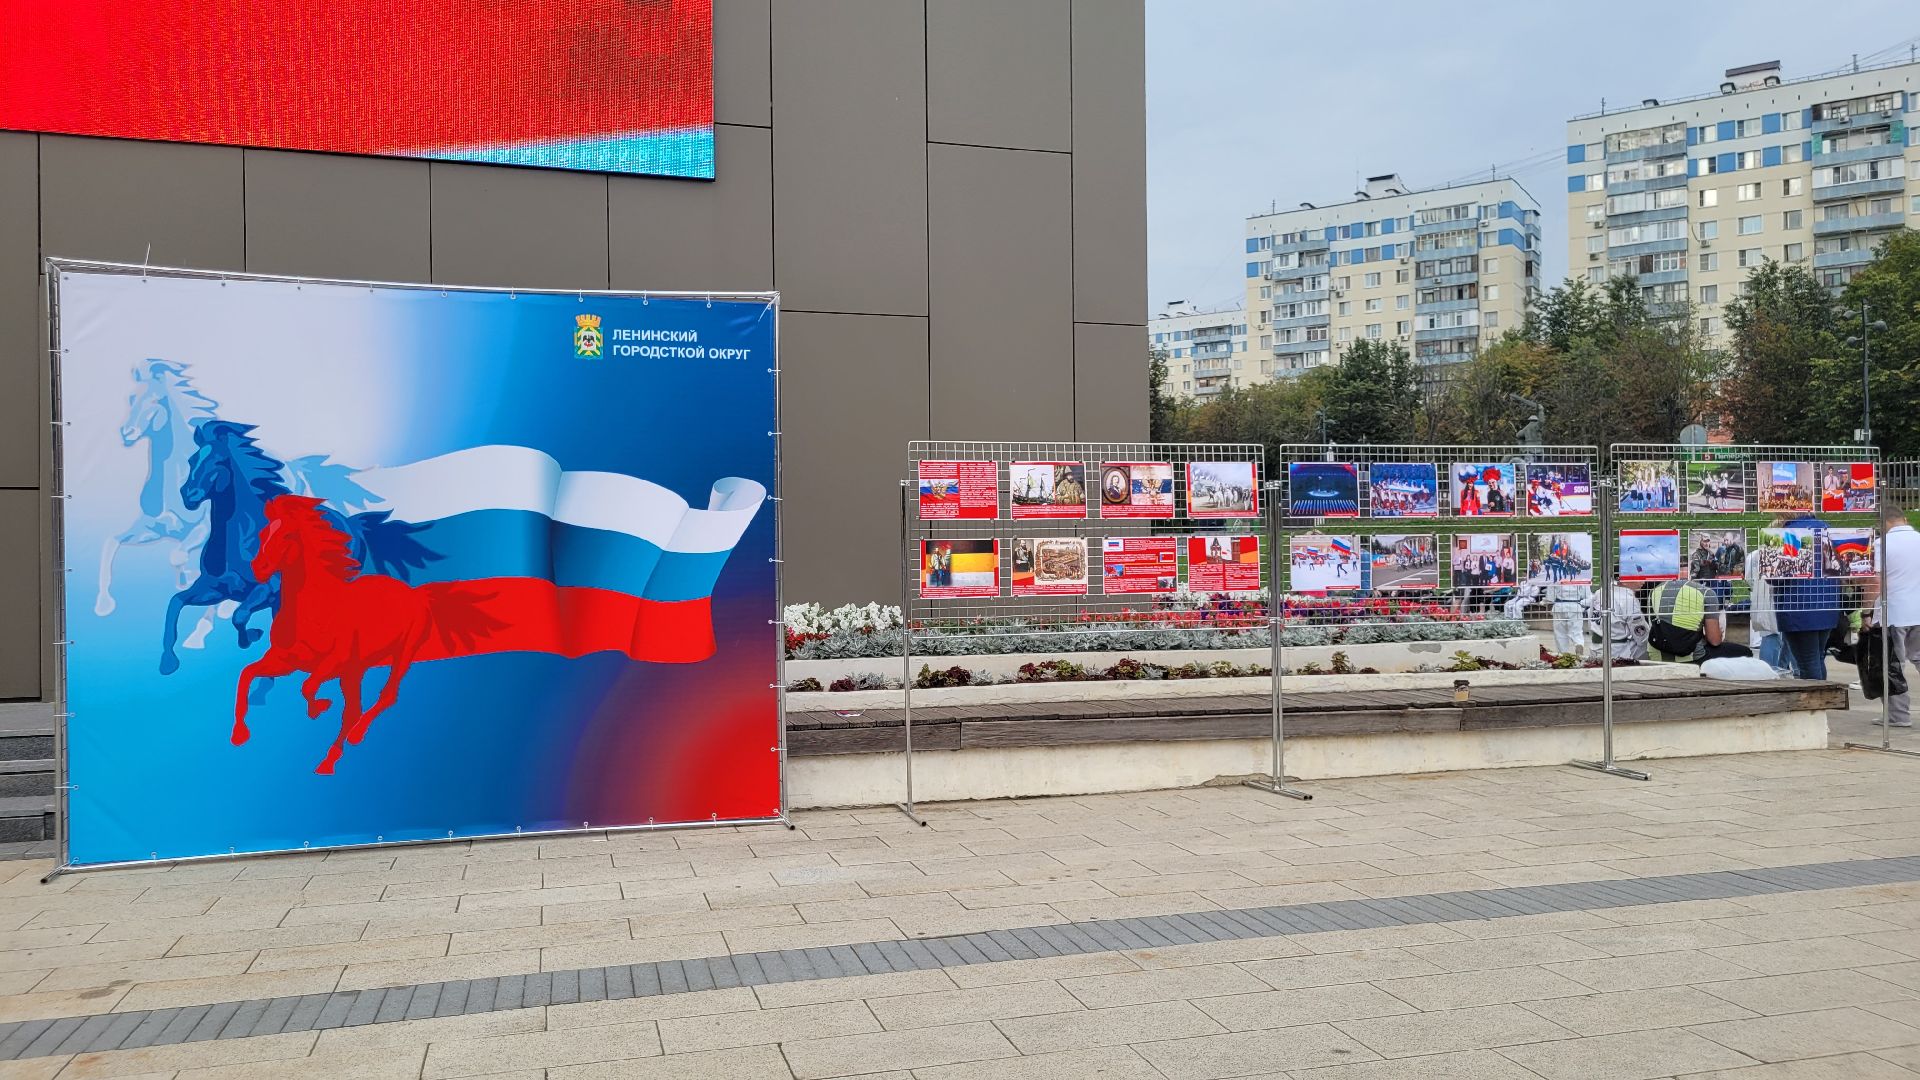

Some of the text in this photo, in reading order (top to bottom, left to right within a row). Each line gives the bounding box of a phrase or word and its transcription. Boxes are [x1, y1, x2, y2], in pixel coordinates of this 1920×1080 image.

[612, 329, 698, 343] ЛЕНИНСКИЙ
[612, 345, 751, 360] ГОРОДСТКОЙ ОКРУГ
